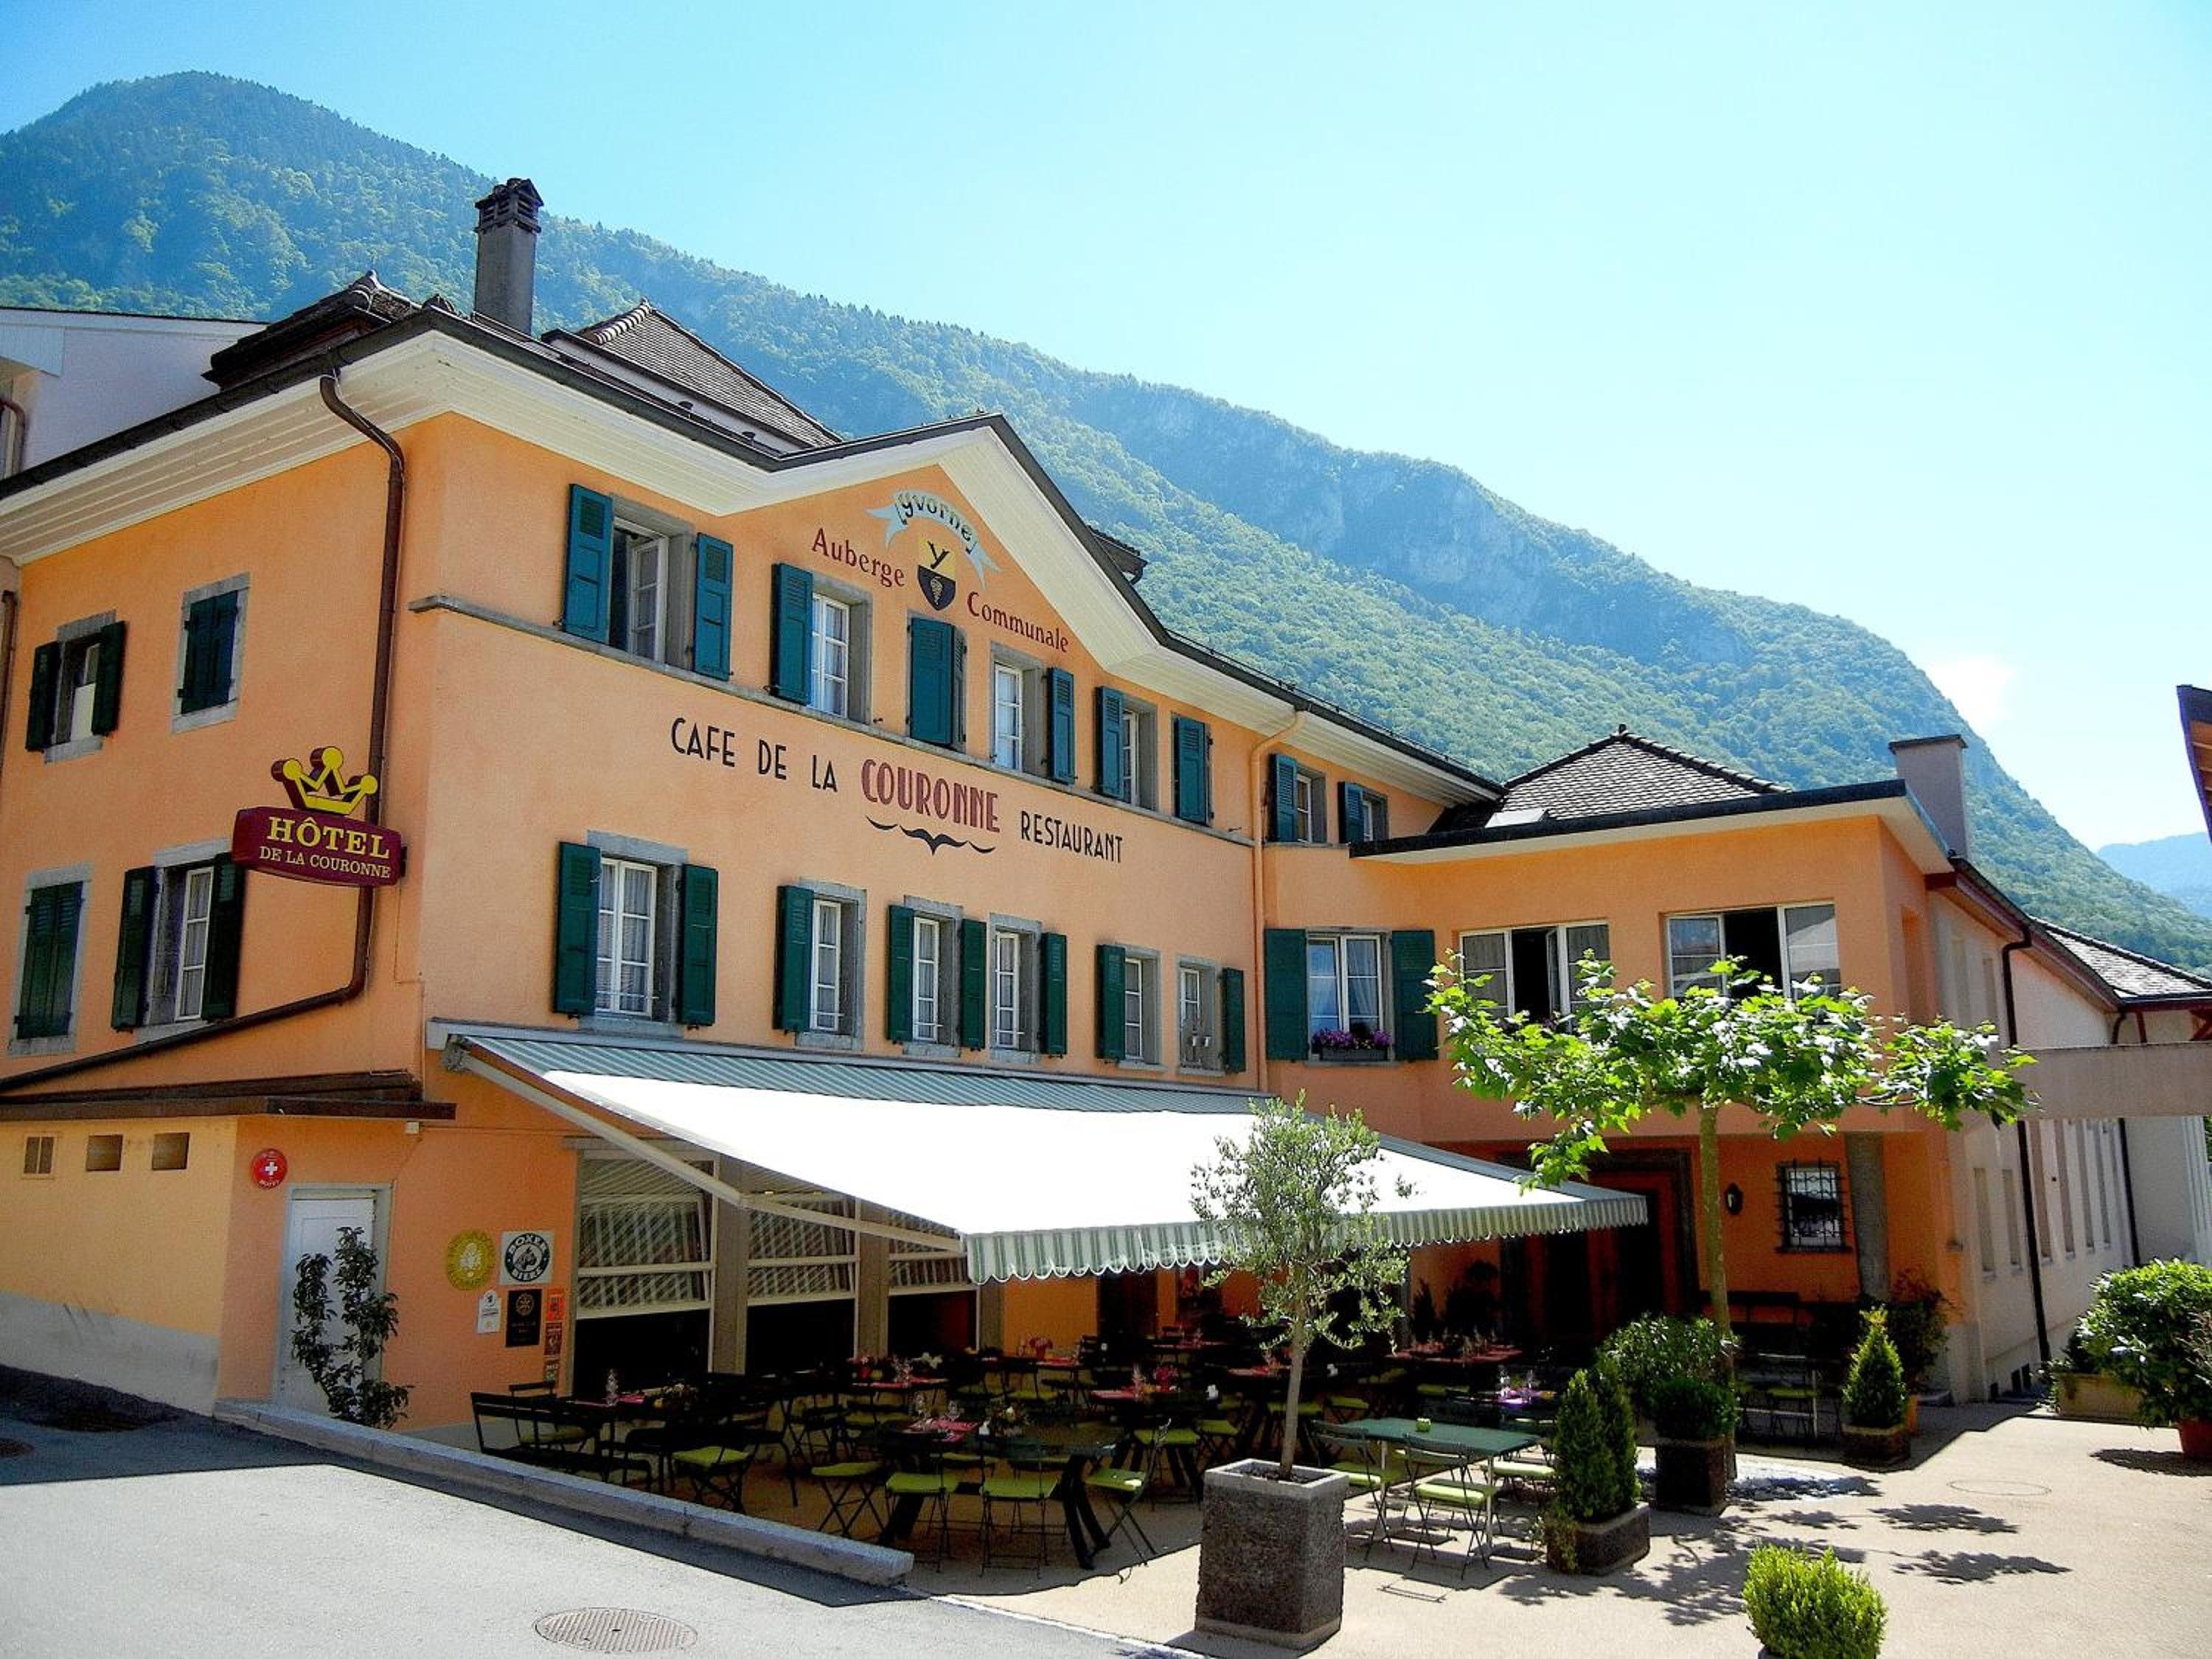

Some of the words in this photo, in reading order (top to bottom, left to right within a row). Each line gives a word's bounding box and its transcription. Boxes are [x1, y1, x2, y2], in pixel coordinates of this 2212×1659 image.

[811, 527, 905, 588] Auberge
[966, 591, 1069, 653] Communale
[671, 717, 735, 768] CAFE
[758, 739, 787, 780] DE
[812, 754, 838, 793] LA
[861, 759, 1000, 832] COURONNE
[1021, 810, 1123, 863] RESTAURANT
[259, 846, 282, 862] DE
[286, 850, 305, 865] LA
[310, 854, 392, 879] COURONNE
[266, 816, 390, 859] HÔTEL
